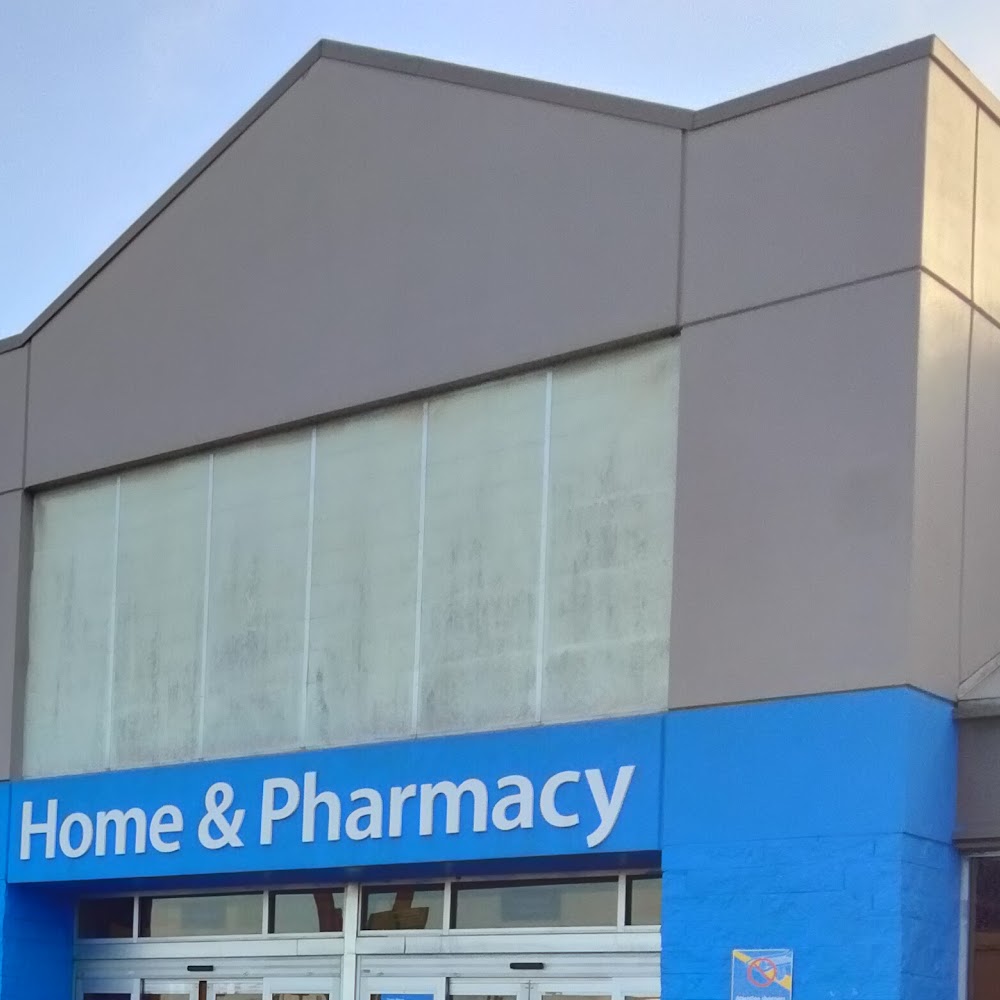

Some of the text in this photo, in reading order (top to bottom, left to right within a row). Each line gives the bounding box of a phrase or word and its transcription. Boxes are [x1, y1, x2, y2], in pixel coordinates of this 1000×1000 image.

[19, 765, 636, 861] Home & Pharmacy
